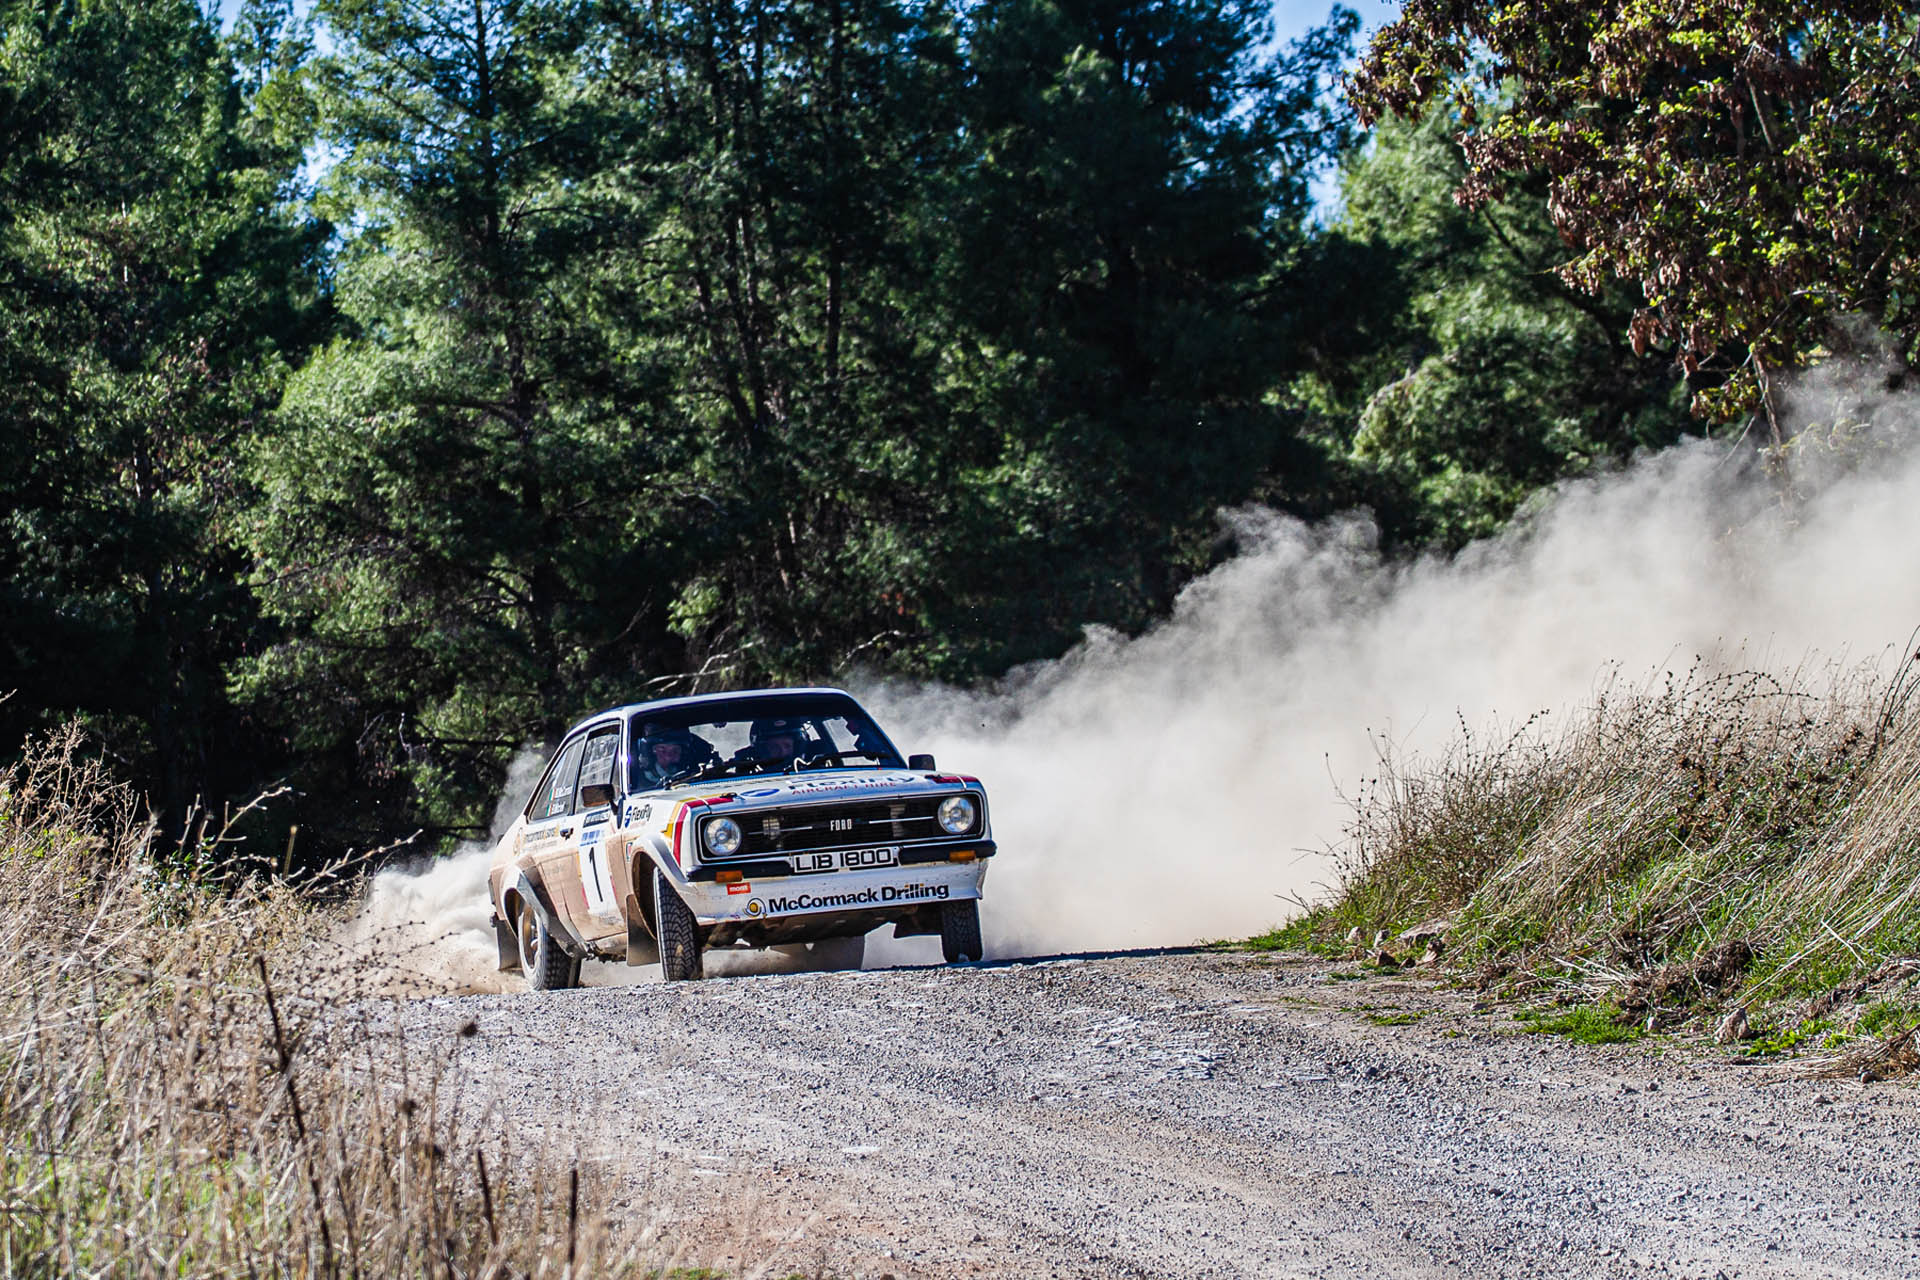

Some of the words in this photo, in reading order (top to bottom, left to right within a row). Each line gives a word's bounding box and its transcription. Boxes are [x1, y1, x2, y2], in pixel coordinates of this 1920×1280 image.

[792, 784, 859, 795] AIRCRAFT
[865, 782, 897, 790] HIRE
[830, 818, 852, 831] FORD
[794, 853, 834, 871] LIB
[840, 848, 892, 867] 1800
[589, 846, 604, 902] 1
[768, 887, 879, 913] McCormack
[881, 883, 950, 901] Drilling
